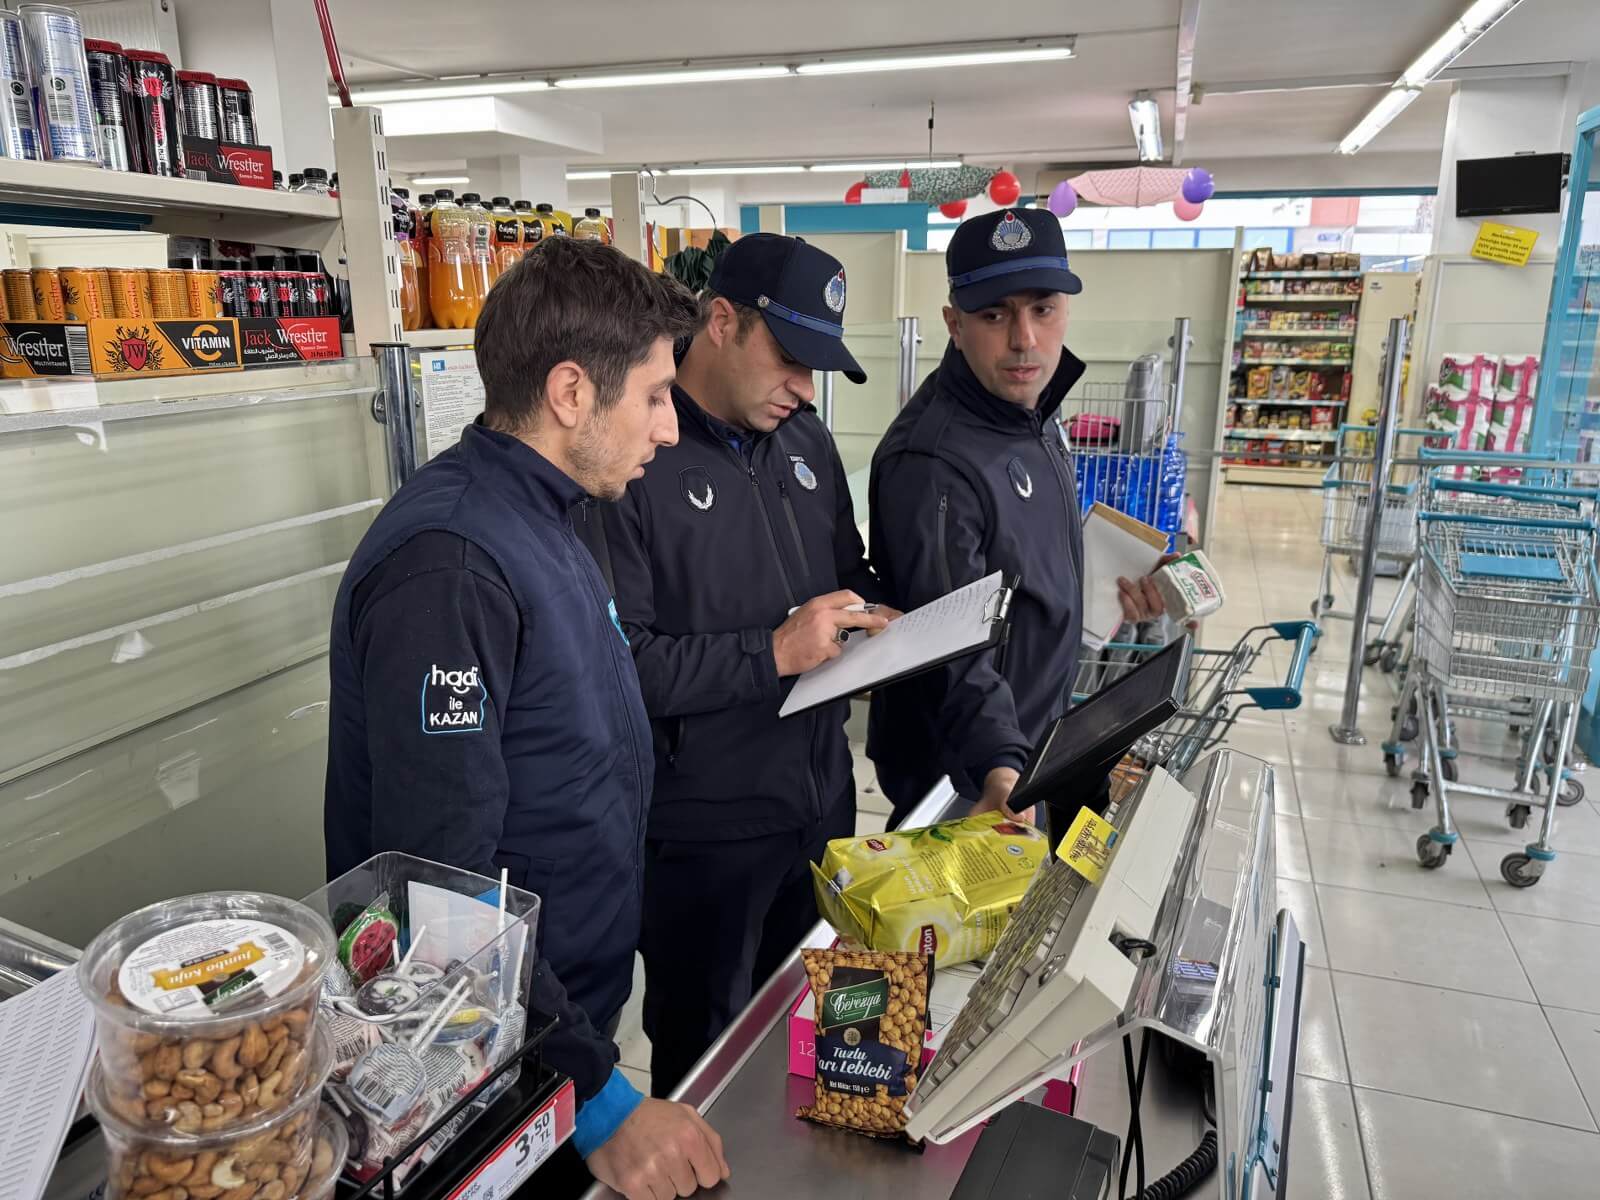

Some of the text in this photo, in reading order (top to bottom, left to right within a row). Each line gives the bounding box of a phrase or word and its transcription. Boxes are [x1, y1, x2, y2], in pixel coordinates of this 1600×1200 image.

[186, 151, 212, 167] Jack
[216, 153, 264, 174] Wrestler
[181, 336, 231, 350] VITAMIN
[243, 328, 328, 347] Jack Wrestler
[4, 334, 64, 361] Wrestler
[125, 343, 145, 359] JW
[431, 664, 478, 687] hadi
[449, 696, 463, 710] ile
[430, 711, 478, 726] KAZAN
[924, 928, 934, 954] pton
[833, 1047, 868, 1060] Tuzlu
[817, 1057, 892, 1080] arı Leblebi
[540, 1128, 551, 1142] TL
